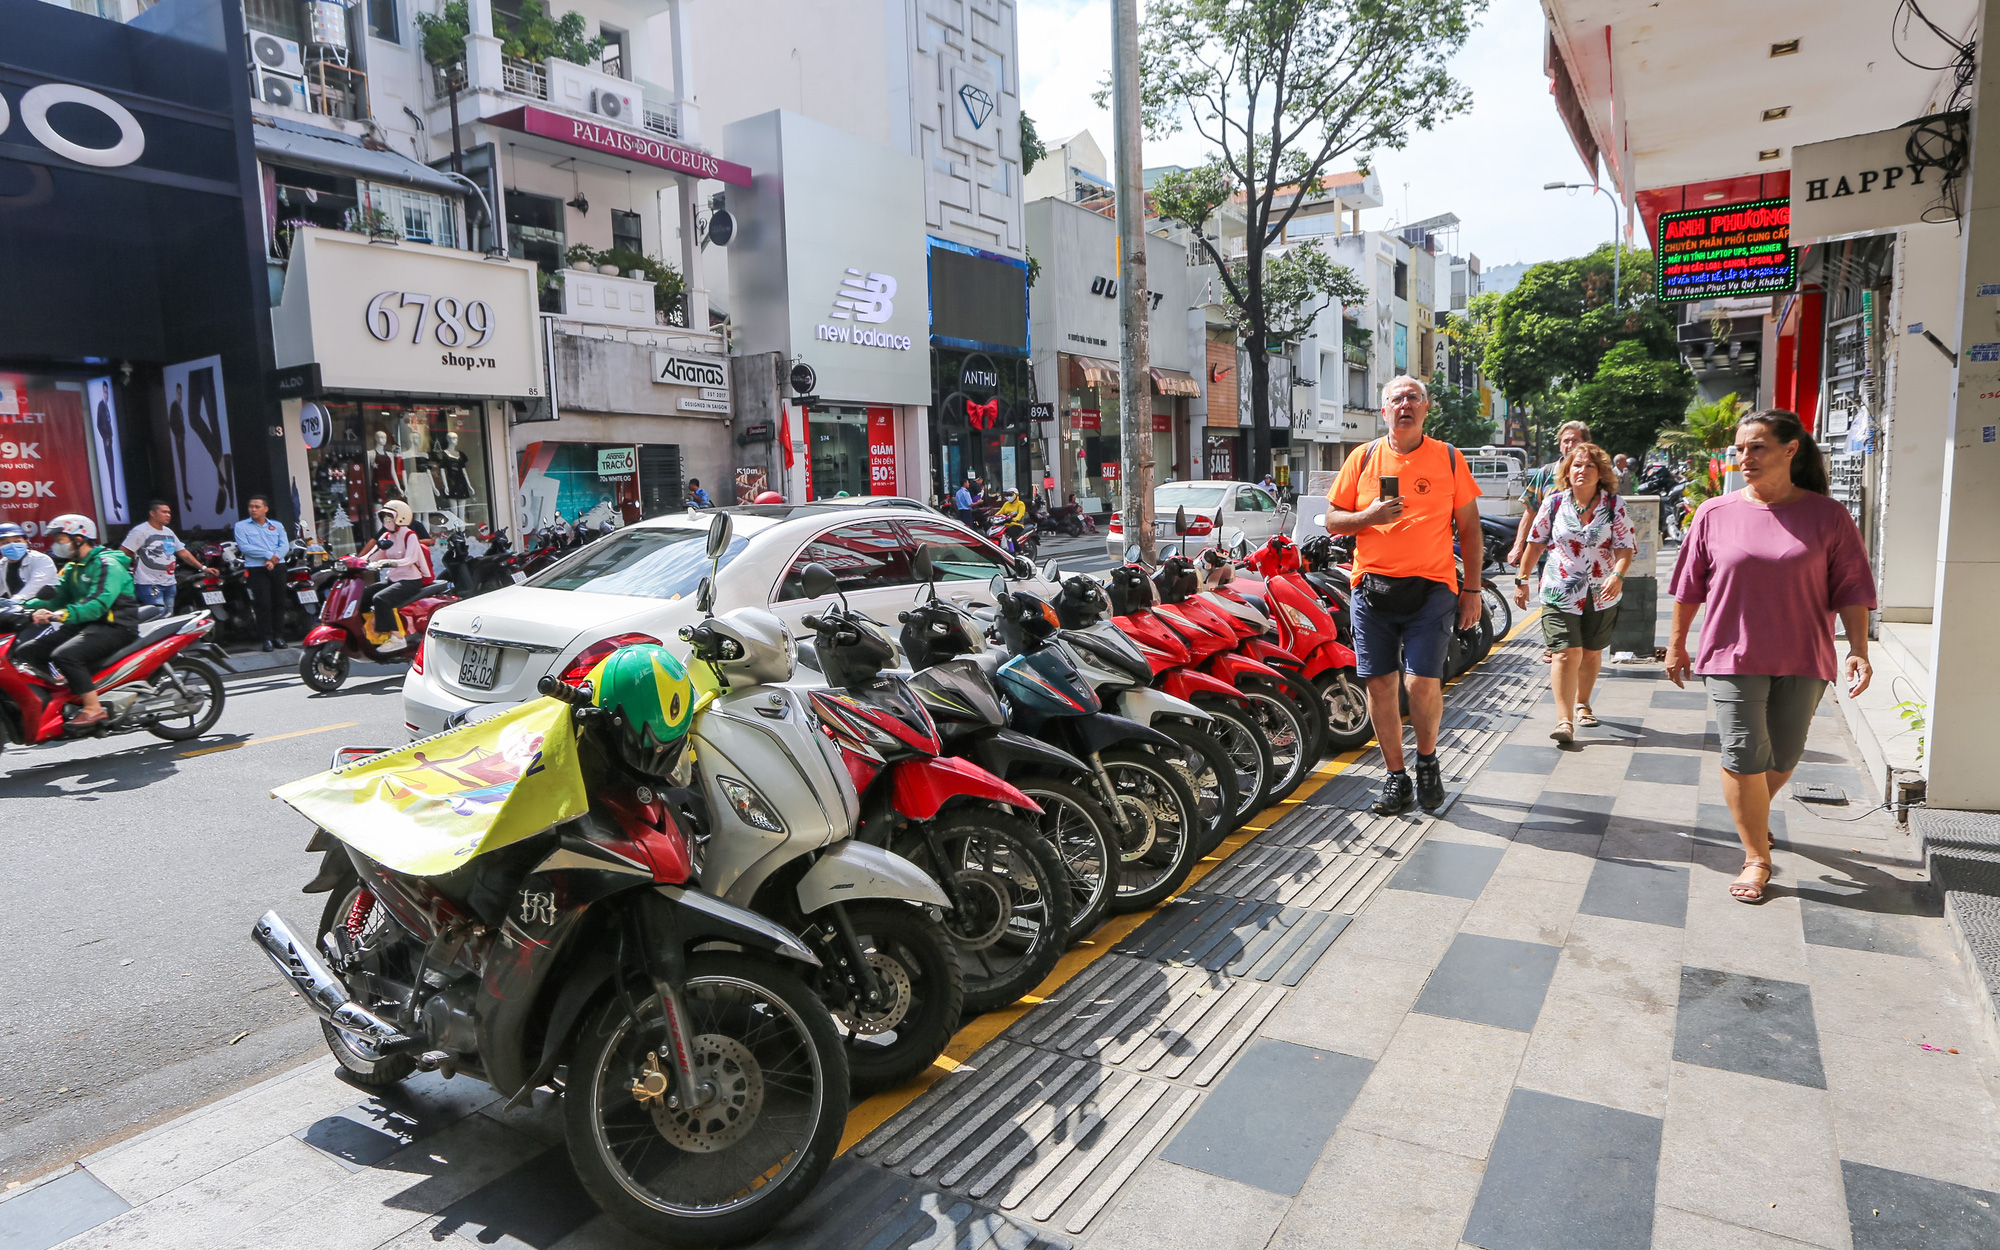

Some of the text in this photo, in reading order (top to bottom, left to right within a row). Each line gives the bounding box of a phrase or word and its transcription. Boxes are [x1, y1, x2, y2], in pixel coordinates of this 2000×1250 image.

[572, 121, 632, 152] PALAIS
[636, 139, 719, 177] DOUCEURS
[1805, 163, 1926, 202] HAPPY
[1665, 207, 1791, 239] ANH PHƯƠNG
[1664, 227, 1790, 252] CHUYÊN PHÂN PHỐI CUNG CẤP
[1682, 253, 1689, 262] VI
[1690, 250, 1706, 261] TÍNH
[1706, 248, 1732, 260] LAPTOP
[1750, 243, 1782, 254] SCANNER
[1682, 264, 1690, 272] IN
[1690, 262, 1704, 272] CÁC
[1774, 253, 1786, 263] HP
[1684, 285, 1705, 296] Hạnh
[1706, 283, 1726, 294] Phục
[1728, 281, 1739, 291] Vụ
[1741, 279, 1757, 289] Quý
[1758, 276, 1785, 287] Khách
[366, 291, 496, 349] 6789
[815, 324, 912, 351] new balance
[441, 352, 497, 371] shop.vn
[660, 357, 724, 386] Ananas
[964, 371, 997, 387] ANTHU
[279, 376, 303, 389] ALDO
[528, 387, 539, 396] 85
[711, 403, 728, 411] SAIGON
[1030, 406, 1049, 417] 89A
[301, 416, 320, 435] 6789
[602, 460, 626, 471] TRACK
[871, 456, 894, 465] LÊN ĐẾN
[1210, 455, 1230, 473] SALE
[1102, 466, 1115, 478] SALE
[471, 646, 488, 664] 51A
[460, 662, 493, 686] 954.02
